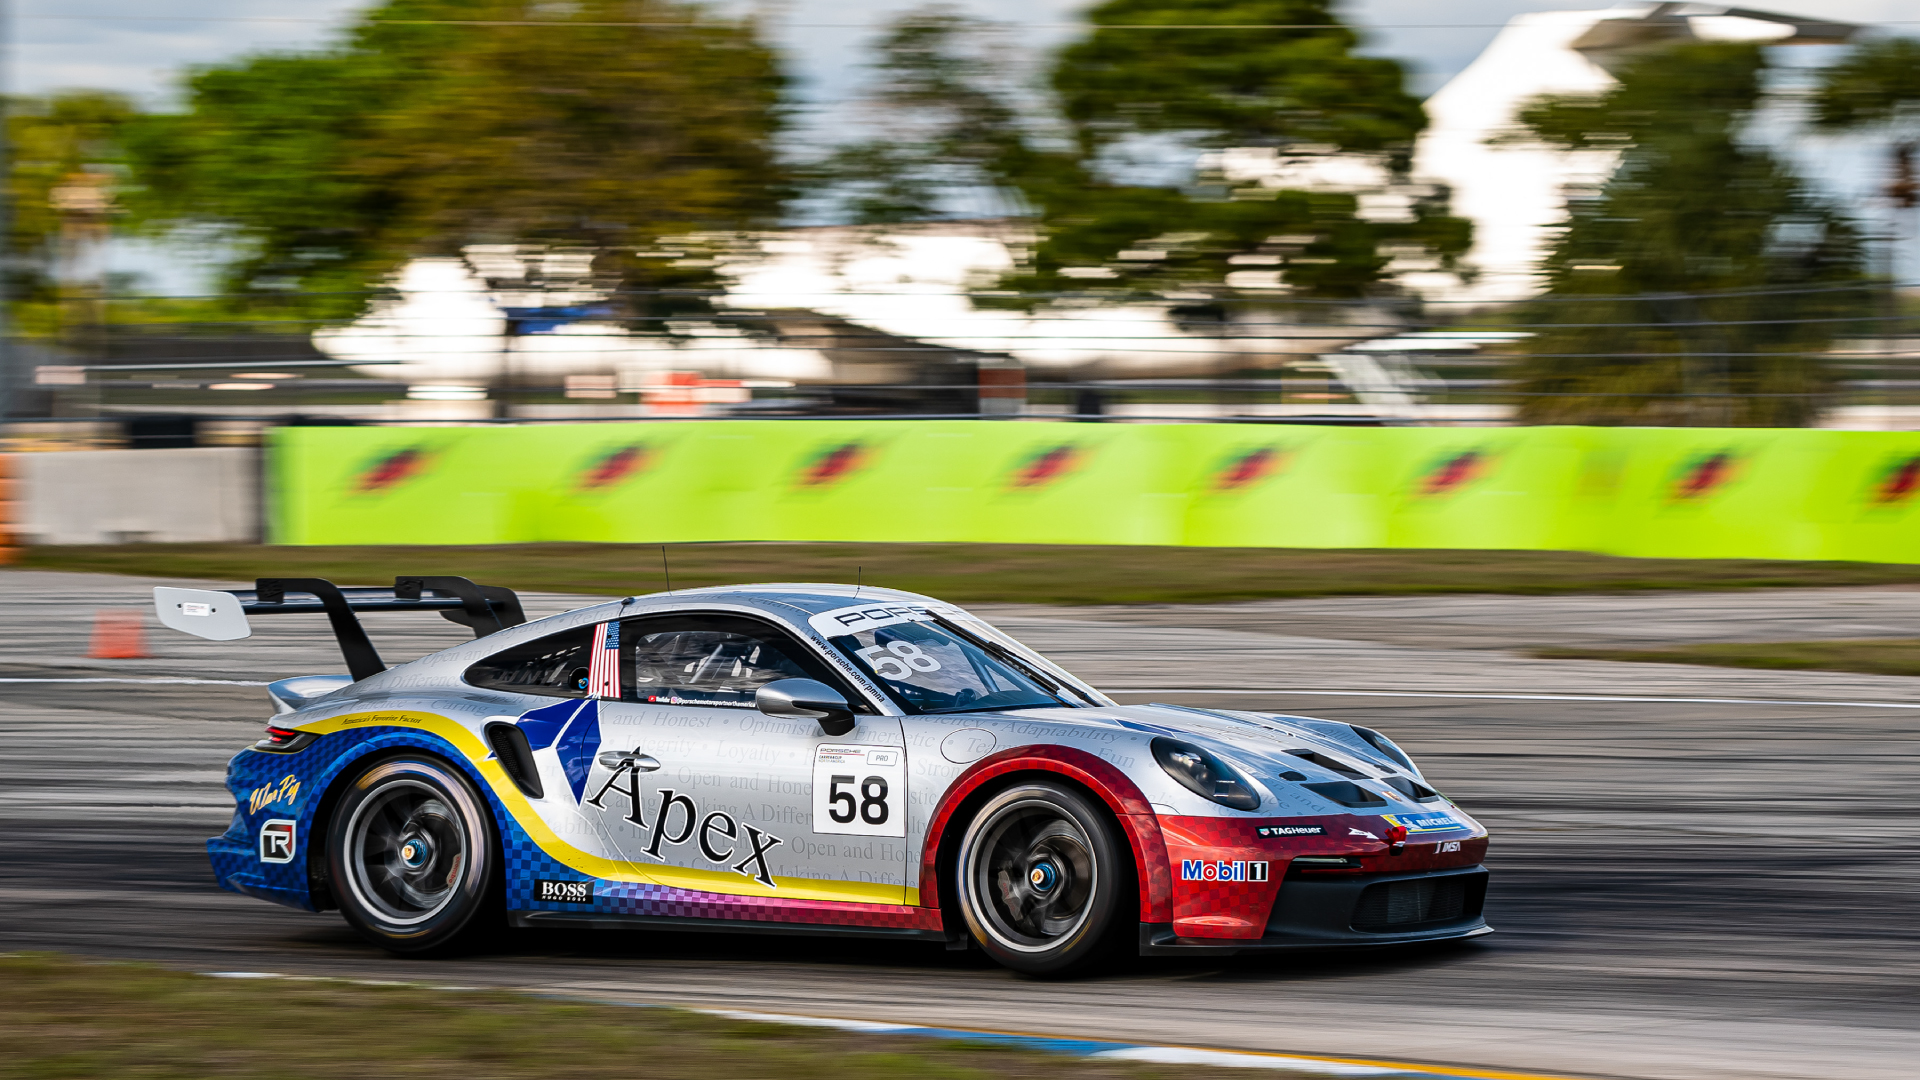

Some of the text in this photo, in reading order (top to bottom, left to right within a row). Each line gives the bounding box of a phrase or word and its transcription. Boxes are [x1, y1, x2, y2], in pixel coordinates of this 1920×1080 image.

[834, 605, 964, 627] PORSC
[810, 634, 886, 703] www.porsche.com/pmna
[854, 640, 942, 681] 58
[430, 700, 489, 716] Caring
[613, 712, 645, 726] and
[653, 712, 712, 728] Honest
[740, 715, 825, 738] Optimistic
[854, 726, 936, 749] Energetic
[1000, 721, 1122, 744] Adaptability
[626, 735, 696, 757] Integrity
[716, 739, 782, 767] Loyalty
[678, 766, 721, 790] Open
[730, 773, 759, 791] and
[742, 803, 757, 820] A
[829, 774, 889, 825] 58
[585, 745, 784, 890] Apex
[791, 836, 837, 859] Open
[843, 842, 874, 860] and
[1182, 860, 1245, 881] Mobil
[542, 881, 587, 897] BOSS
